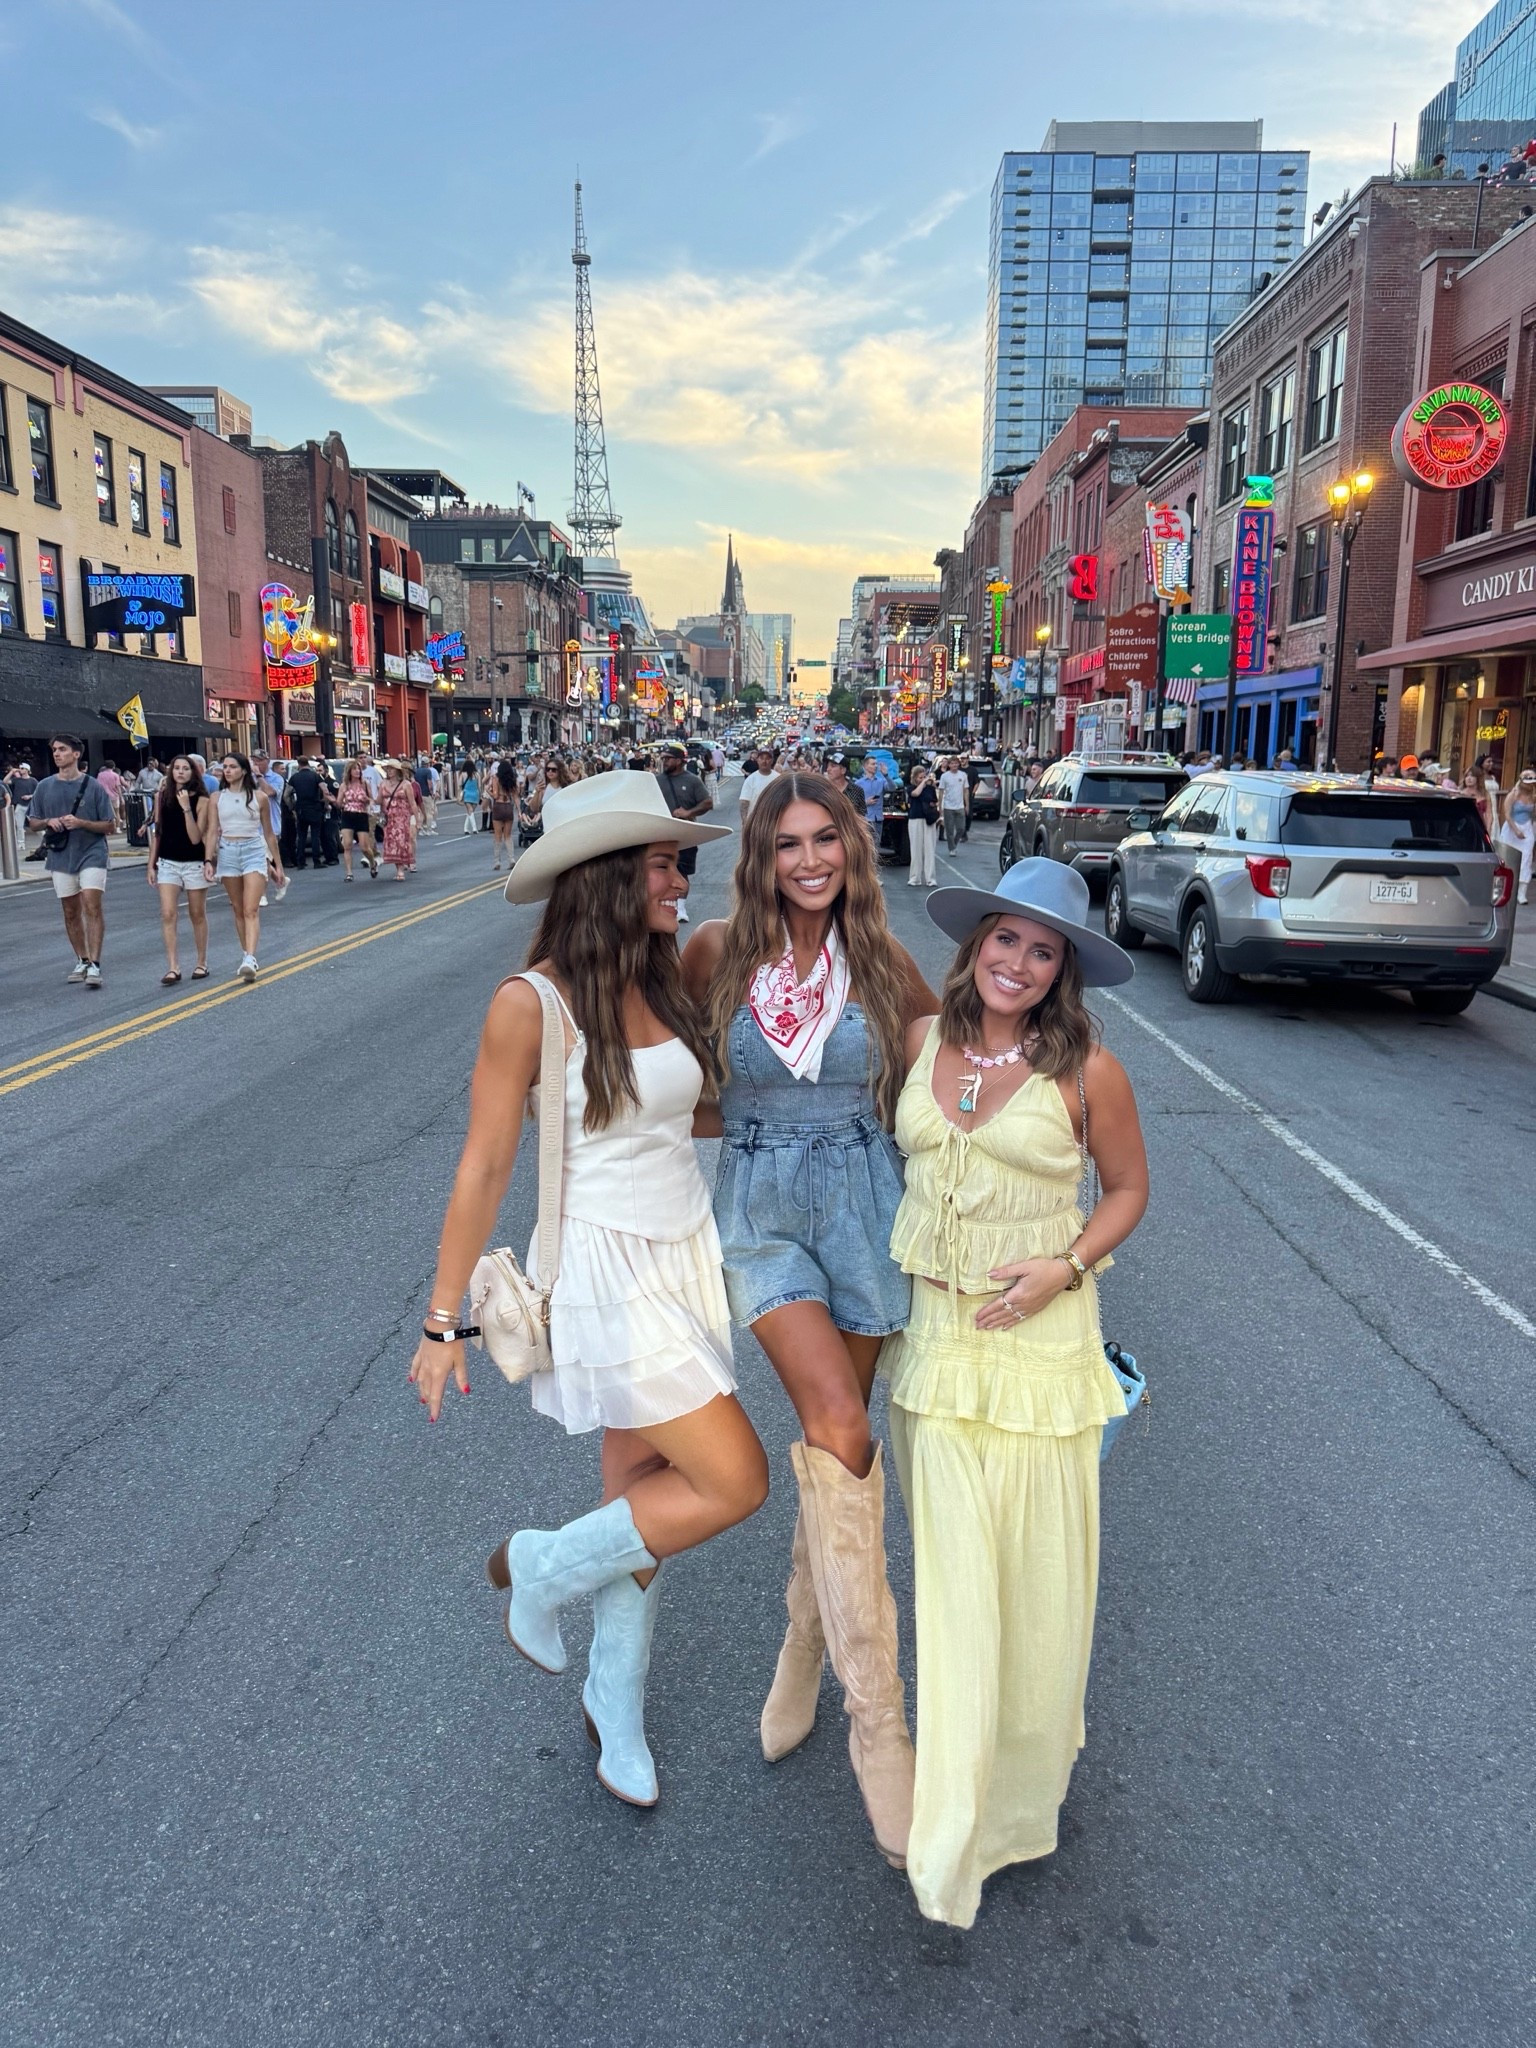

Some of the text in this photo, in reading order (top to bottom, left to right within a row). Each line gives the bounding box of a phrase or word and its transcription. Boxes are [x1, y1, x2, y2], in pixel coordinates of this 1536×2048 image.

[1413, 385, 1501, 424] SAVANNAH'S
[1408, 437, 1501, 485] CANDY KITCHEN
[1154, 509, 1181, 525] Tin
[1153, 523, 1185, 543] Roof
[88, 575, 183, 585] BROADWAY
[1462, 566, 1536, 607] CANDY KI
[88, 584, 184, 608] BREWHOUSE
[1236, 516, 1260, 669] KANE BROWNS
[128, 600, 142, 611] &
[125, 611, 165, 630] MOJO
[1171, 622, 1207, 631] Korean
[1109, 628, 1134, 636] SoBro
[1171, 633, 1230, 645] Vets Bridge
[1109, 636, 1156, 646] Attractions
[1108, 652, 1149, 661] Childrens
[267, 665, 314, 677] BETTY
[933, 652, 943, 690] SALOON
[1109, 662, 1141, 671] Theatre
[270, 675, 314, 688] BOOTS
[1376, 886, 1412, 898] 1277-GJ
[545, 1069, 560, 1154] LOUIS VUITTON
[542, 1182, 556, 1267] LOUIS VUITTON
